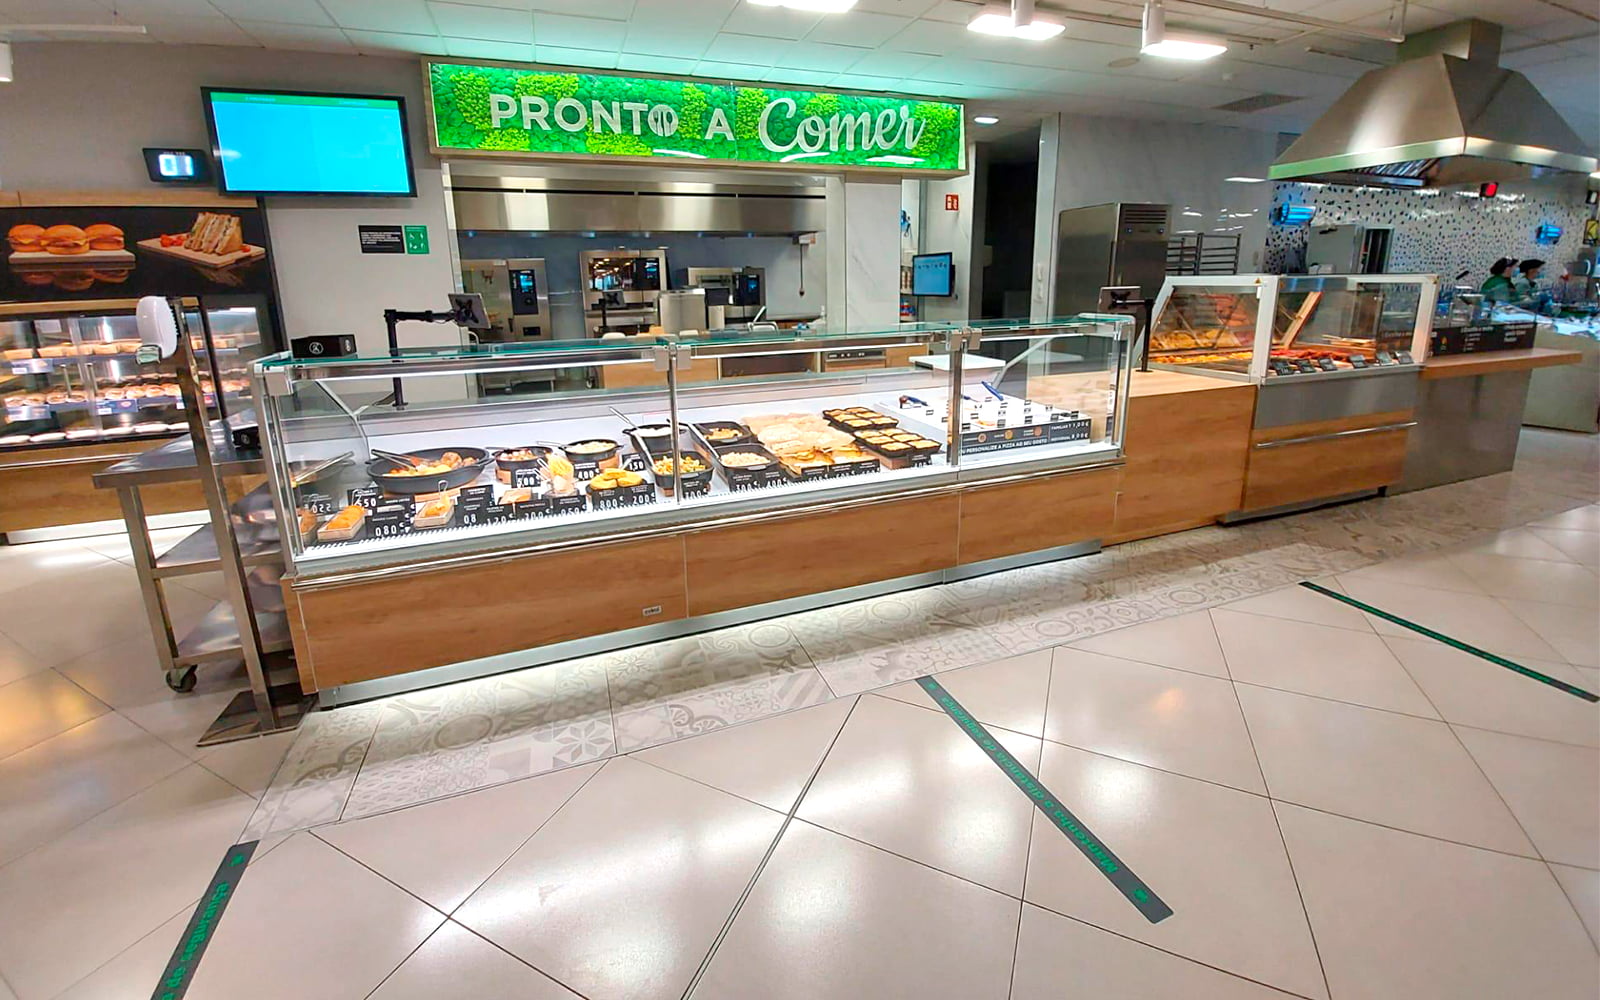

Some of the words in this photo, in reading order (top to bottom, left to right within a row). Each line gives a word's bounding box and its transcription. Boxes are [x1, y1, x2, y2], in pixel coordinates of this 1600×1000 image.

[489, 93, 679, 137] PRONTO
[704, 108, 735, 141] A
[758, 97, 926, 153] Comer
[966, 444, 998, 453] PERSONALIZE
[180, 882, 230, 962] segurança
